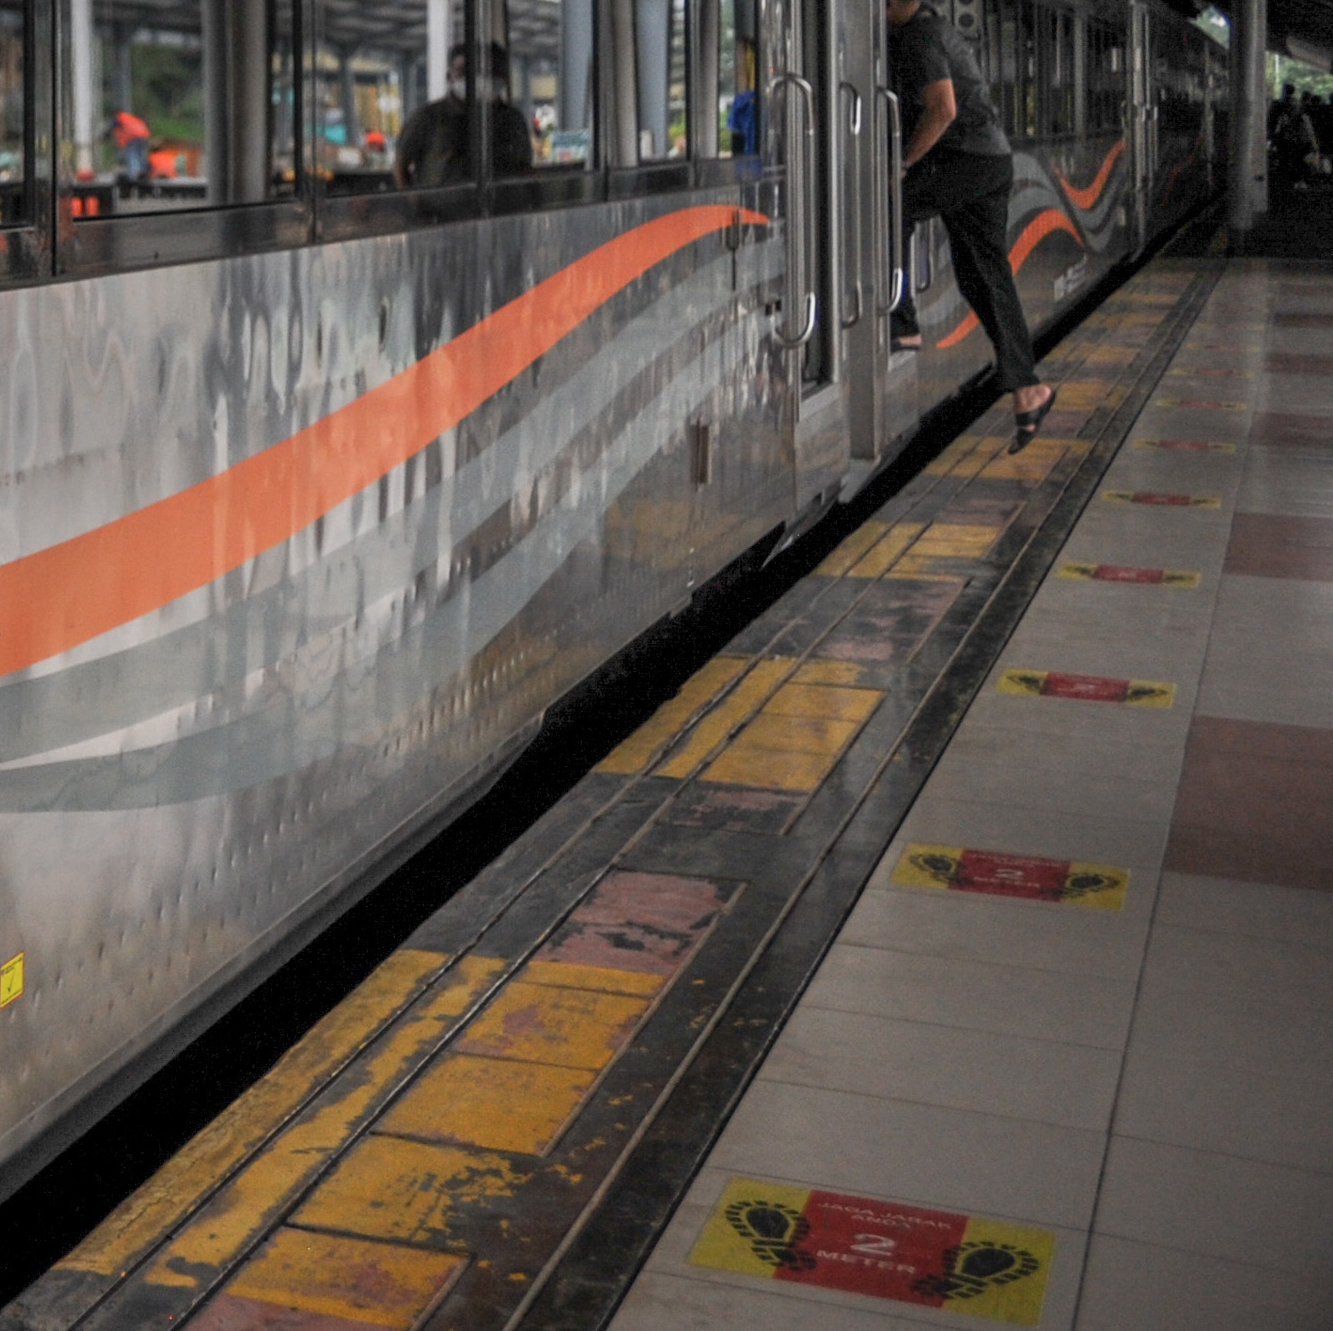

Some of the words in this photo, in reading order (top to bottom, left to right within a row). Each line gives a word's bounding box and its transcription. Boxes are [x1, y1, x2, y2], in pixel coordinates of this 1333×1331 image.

[817, 1201, 875, 1217] JAGA
[879, 1211, 952, 1230] JARAK
[850, 1232, 897, 1257] 2
[816, 1249, 917, 1275] METER
